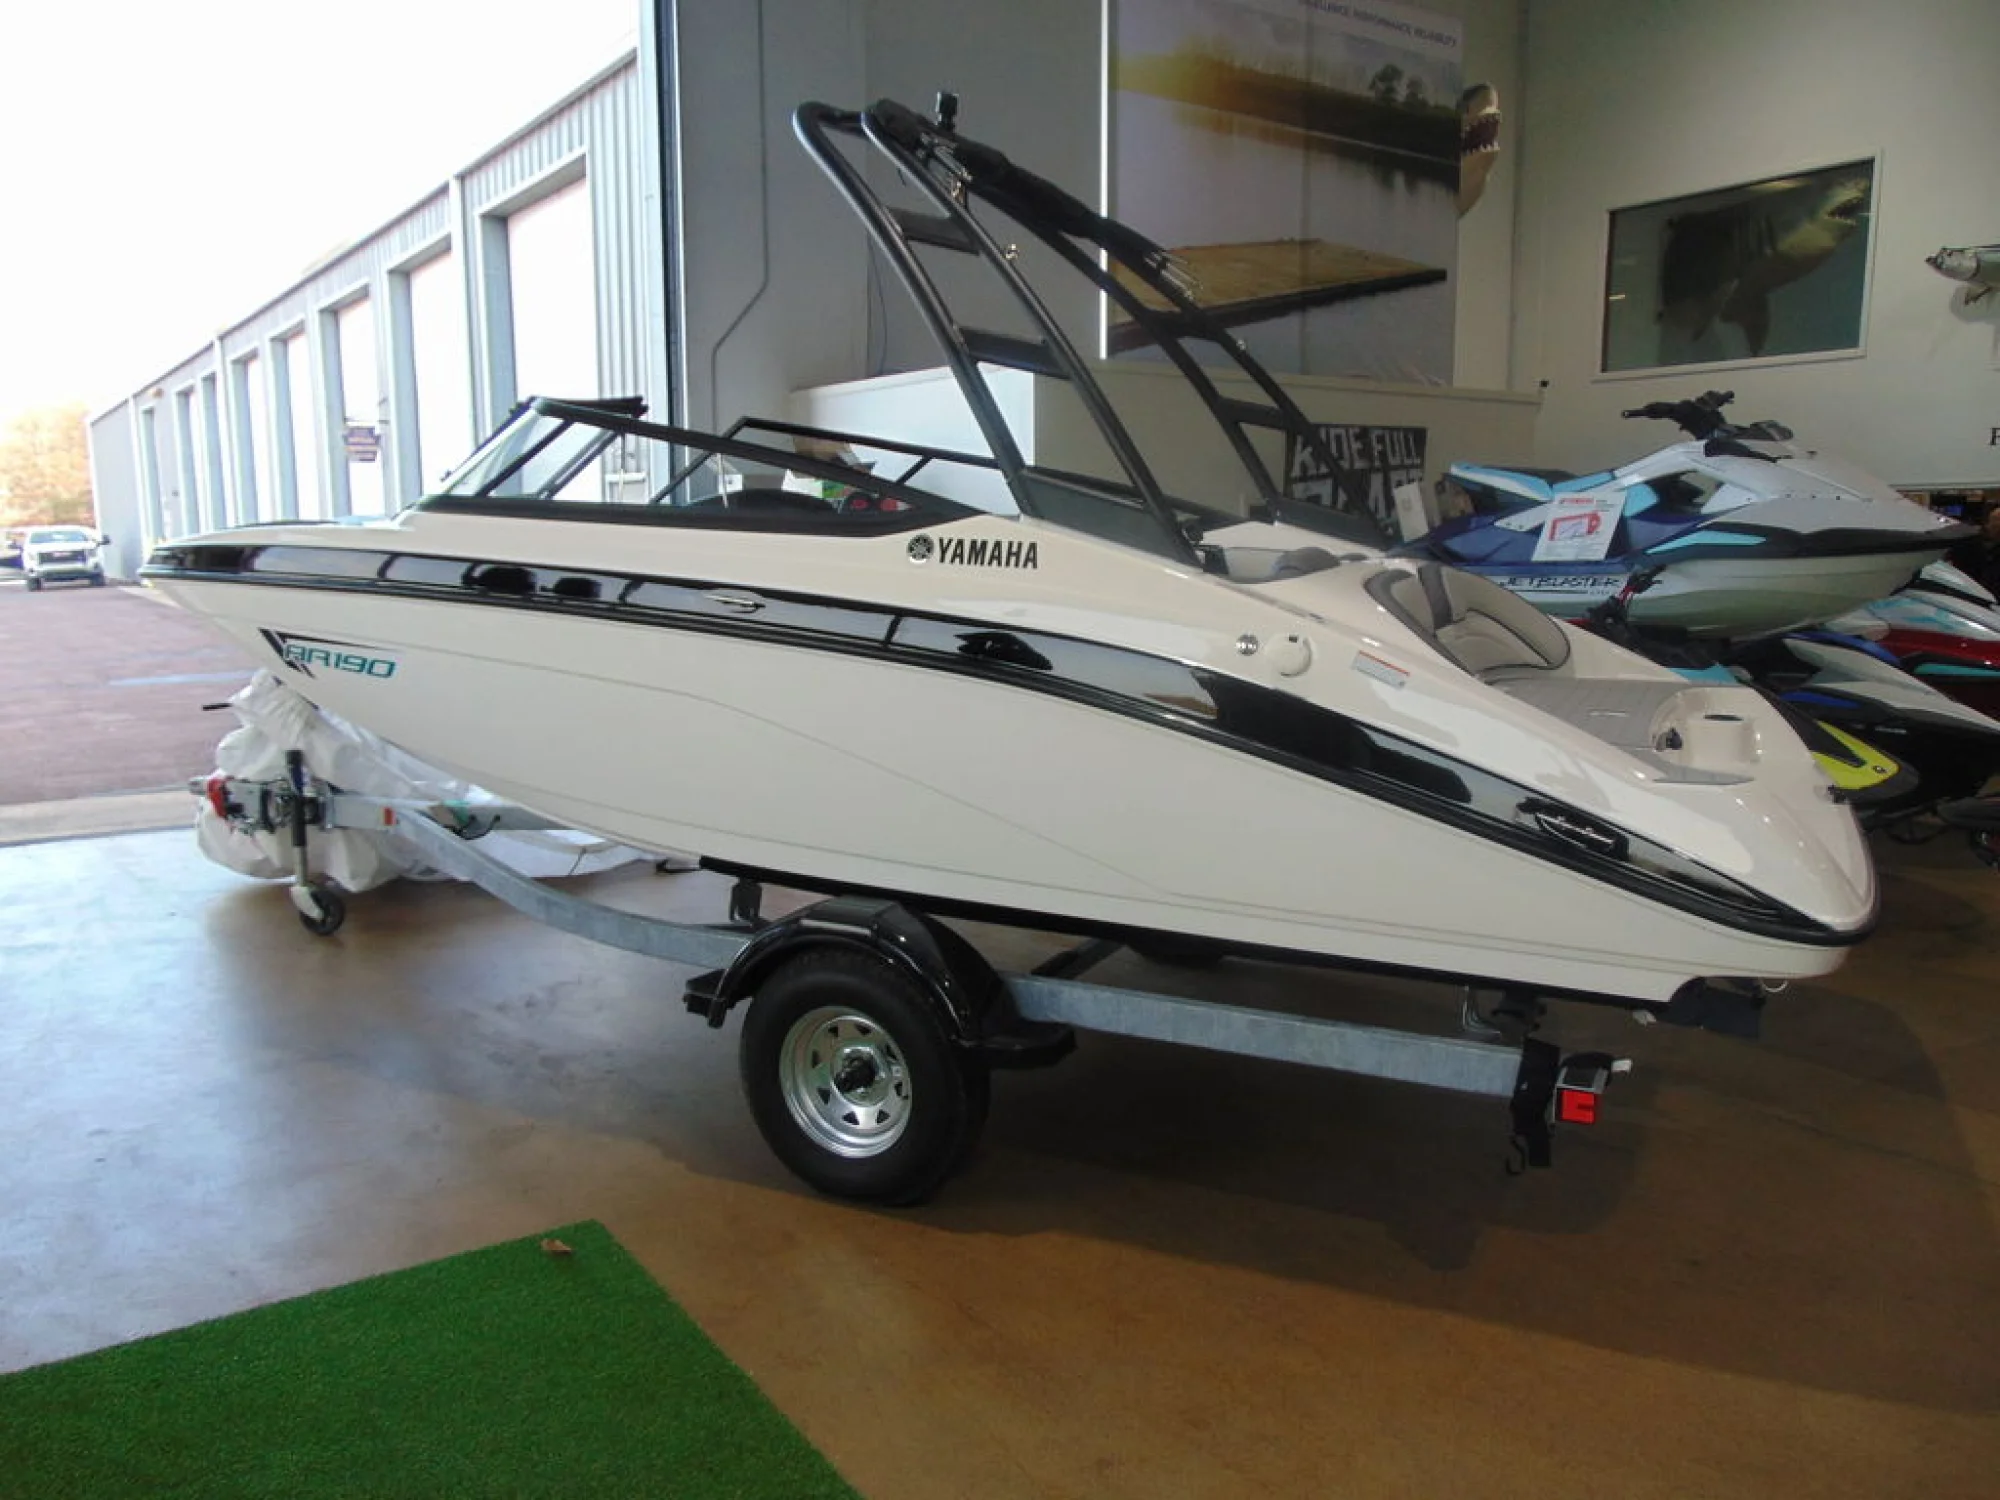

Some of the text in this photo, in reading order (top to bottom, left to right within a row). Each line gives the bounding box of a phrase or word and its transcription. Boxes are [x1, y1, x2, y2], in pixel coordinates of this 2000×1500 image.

[1371, 429, 1421, 467] FULL
[938, 536, 1038, 569] YAMAHA
[284, 643, 396, 678] AR190
